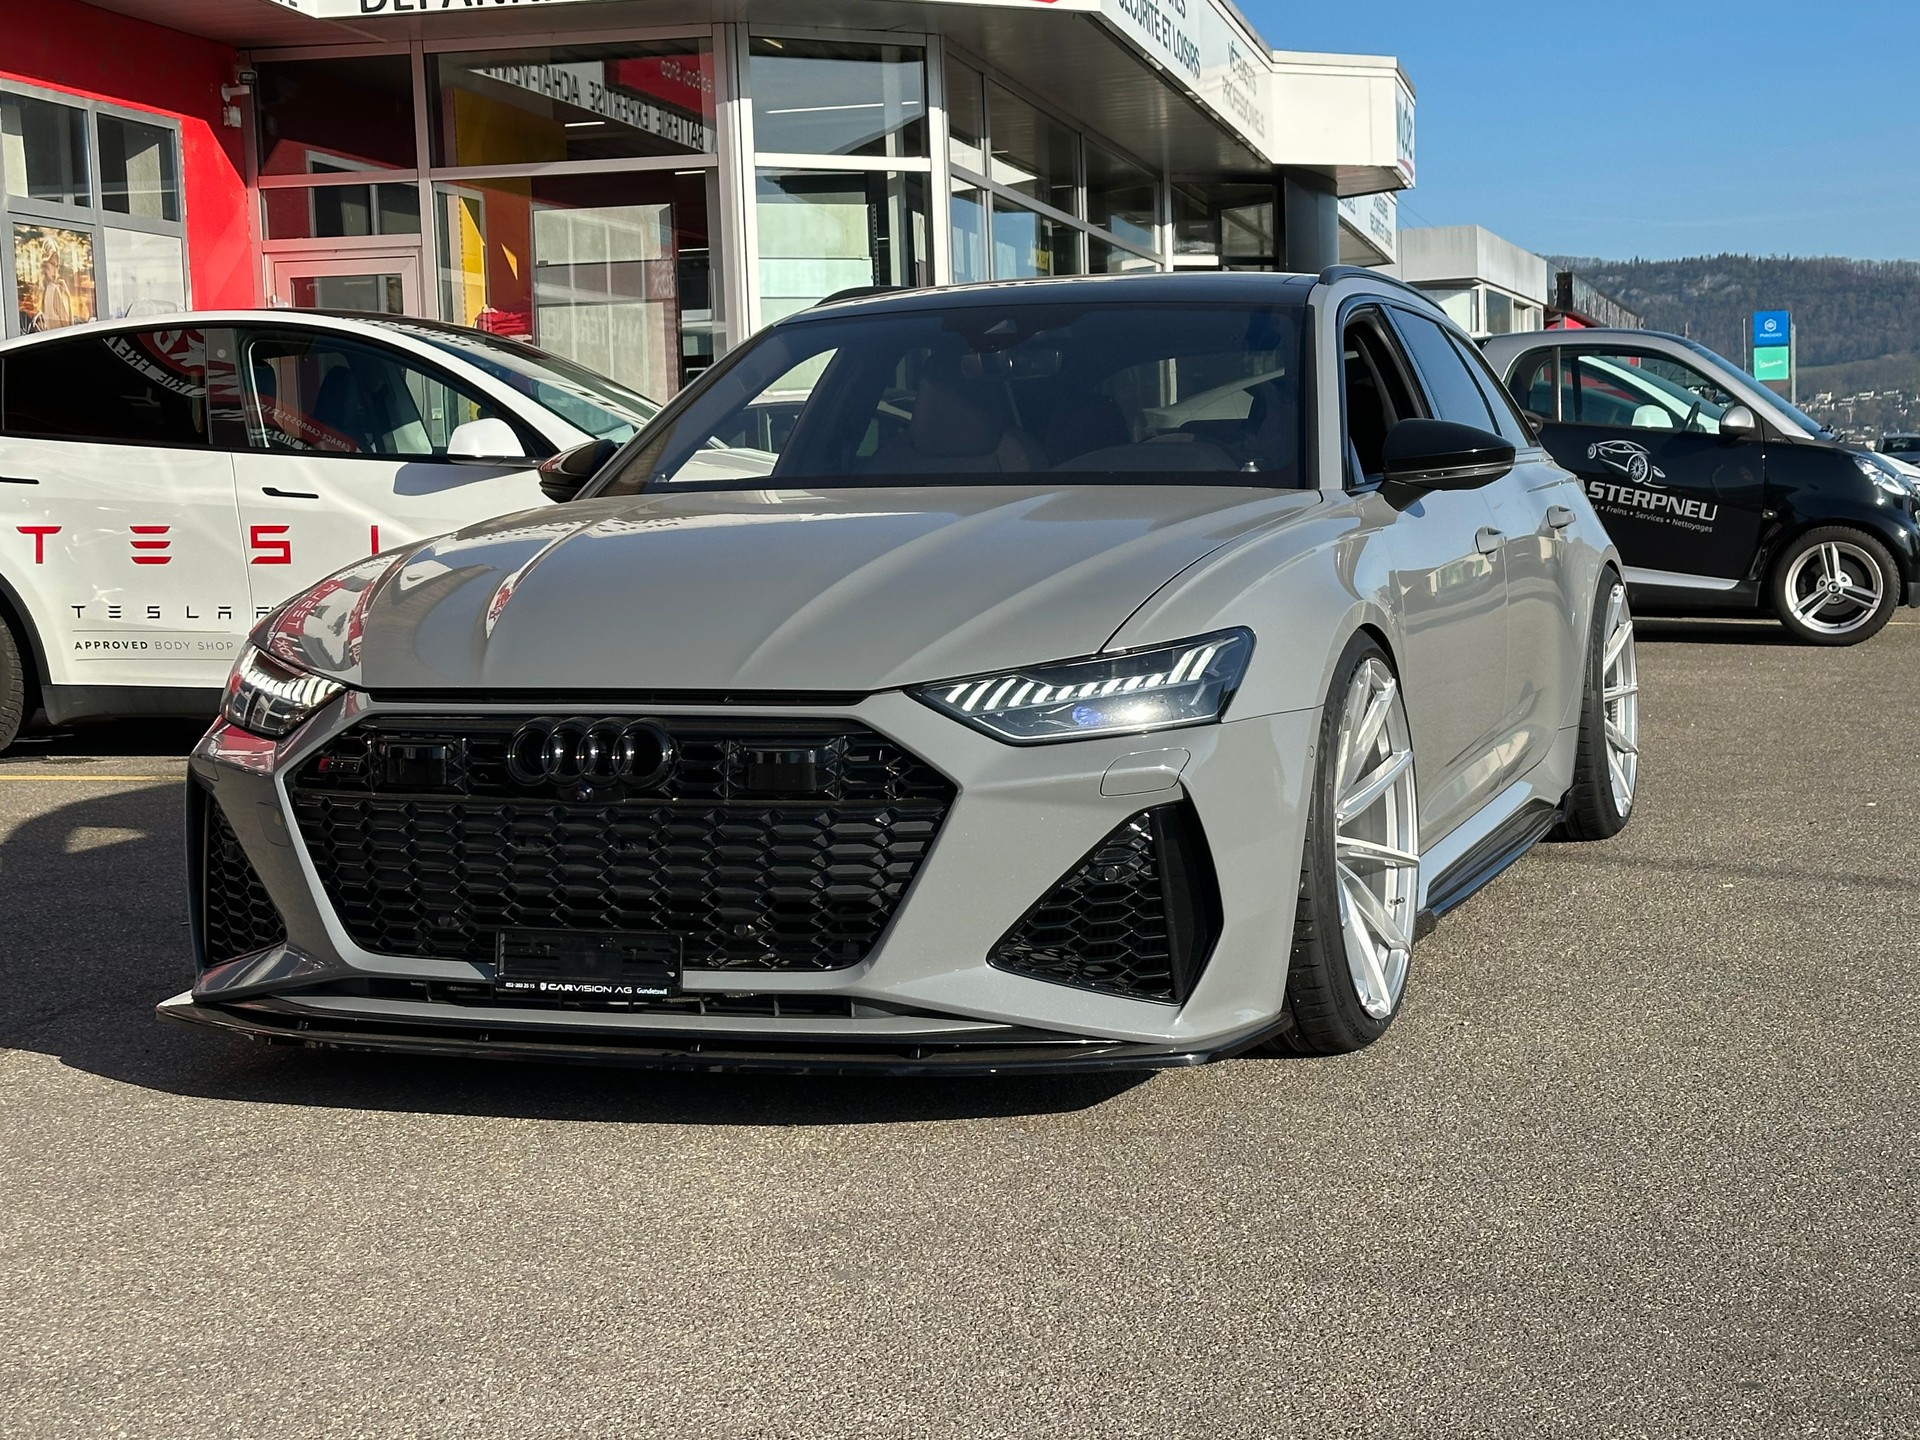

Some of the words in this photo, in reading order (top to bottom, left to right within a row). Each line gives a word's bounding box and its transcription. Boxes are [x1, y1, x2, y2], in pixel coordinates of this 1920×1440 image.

[1119, 0, 1161, 43] CURITÉ
[1161, 13, 1171, 52] ET
[1172, 24, 1201, 80] LOISIRS
[1606, 505, 1628, 516] Freins
[1635, 511, 1664, 523] Services
[1672, 518, 1713, 533] Nettoyages
[74, 640, 149, 650] APPROVED
[154, 641, 191, 651] BODY
[197, 641, 234, 651] SHOP
[547, 983, 612, 993] CARVISION
[614, 986, 633, 994] AG
